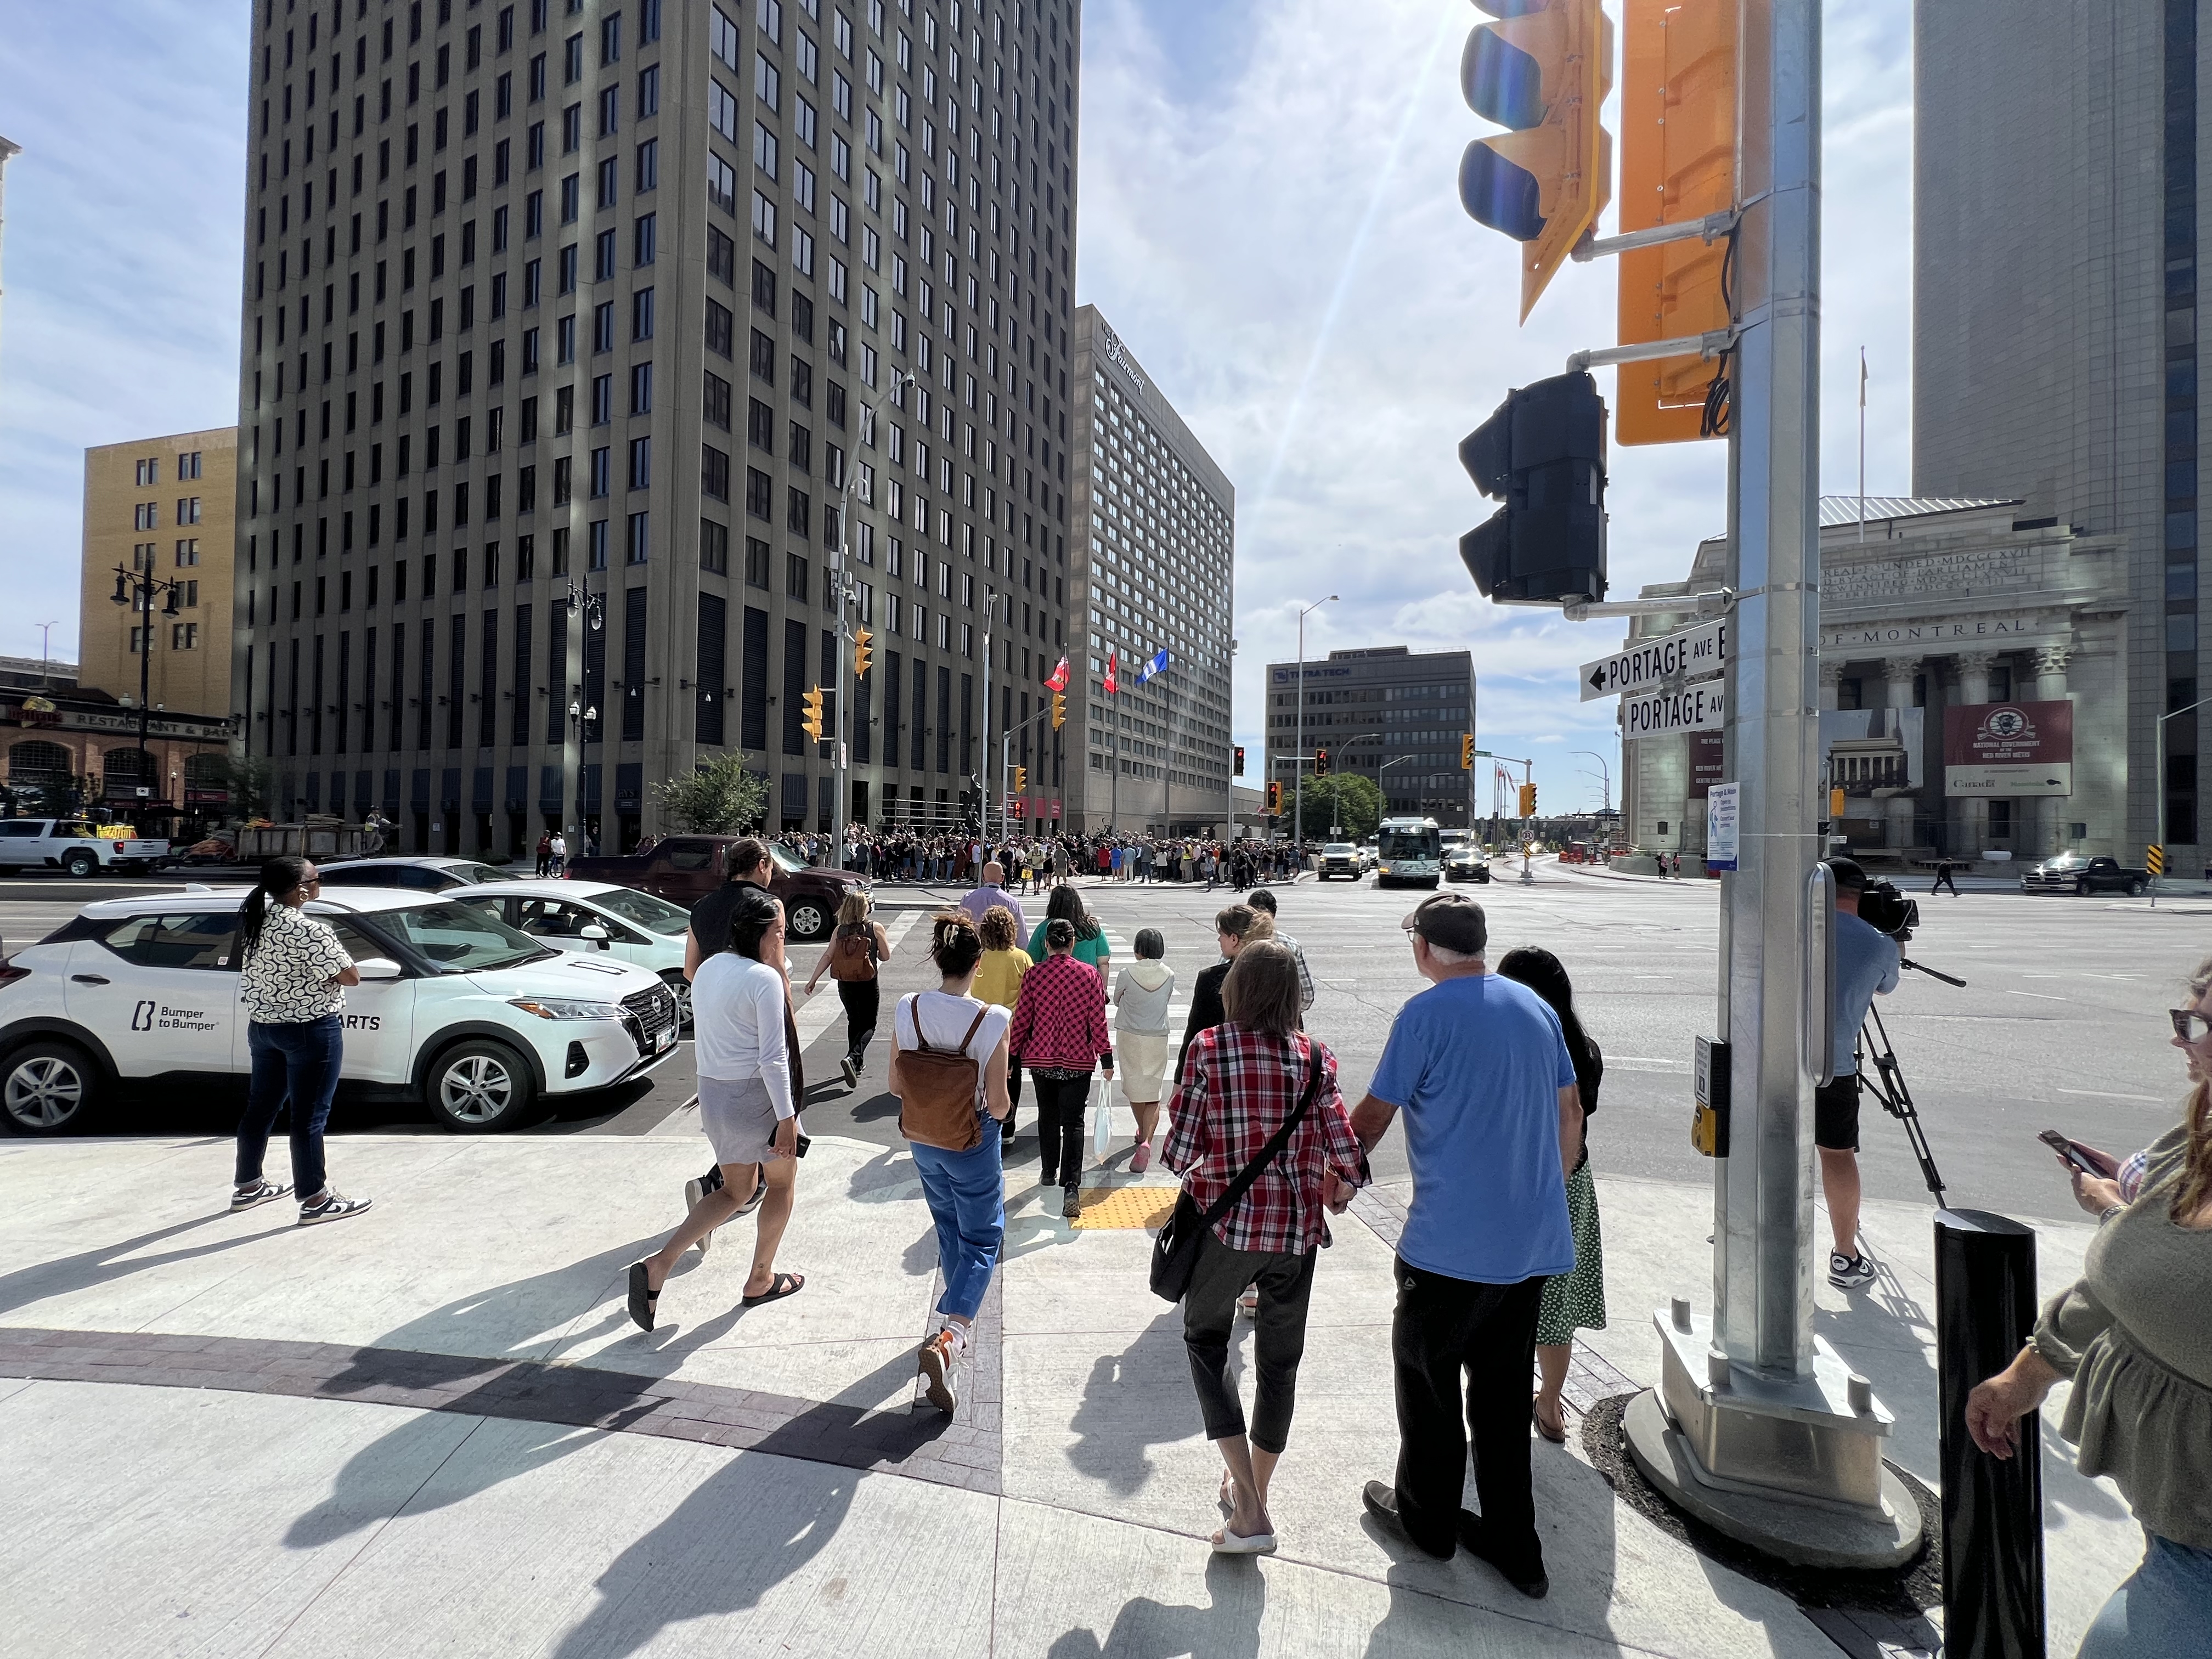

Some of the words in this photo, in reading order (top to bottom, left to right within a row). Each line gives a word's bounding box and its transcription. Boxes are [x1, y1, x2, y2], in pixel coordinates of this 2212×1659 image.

[1105, 331, 1145, 396] Fairmont
[1862, 573, 1887, 582] ACT
[1894, 570, 1909, 578] OF
[1918, 560, 2019, 576] PARLIAMENT
[1864, 558, 1934, 574] FOUNDED
[1838, 579, 1908, 591] WINNIPEG
[1846, 587, 1905, 599] ERECTED
[1865, 620, 2024, 642] MONTREAL
[1610, 639, 1687, 689] PORTAGE
[1694, 638, 1712, 659] AVE
[1323, 668, 1351, 676] TECH
[1630, 690, 1704, 732] PORTAGE
[77, 715, 179, 732] RESTAUANT
[184, 726, 195, 734] &
[1954, 780, 1995, 788] Canada
[161, 1007, 204, 1019] Bumper
[159, 1019, 170, 1027] to
[172, 1019, 216, 1031] Bumper
[337, 1014, 381, 1030] ARTS
